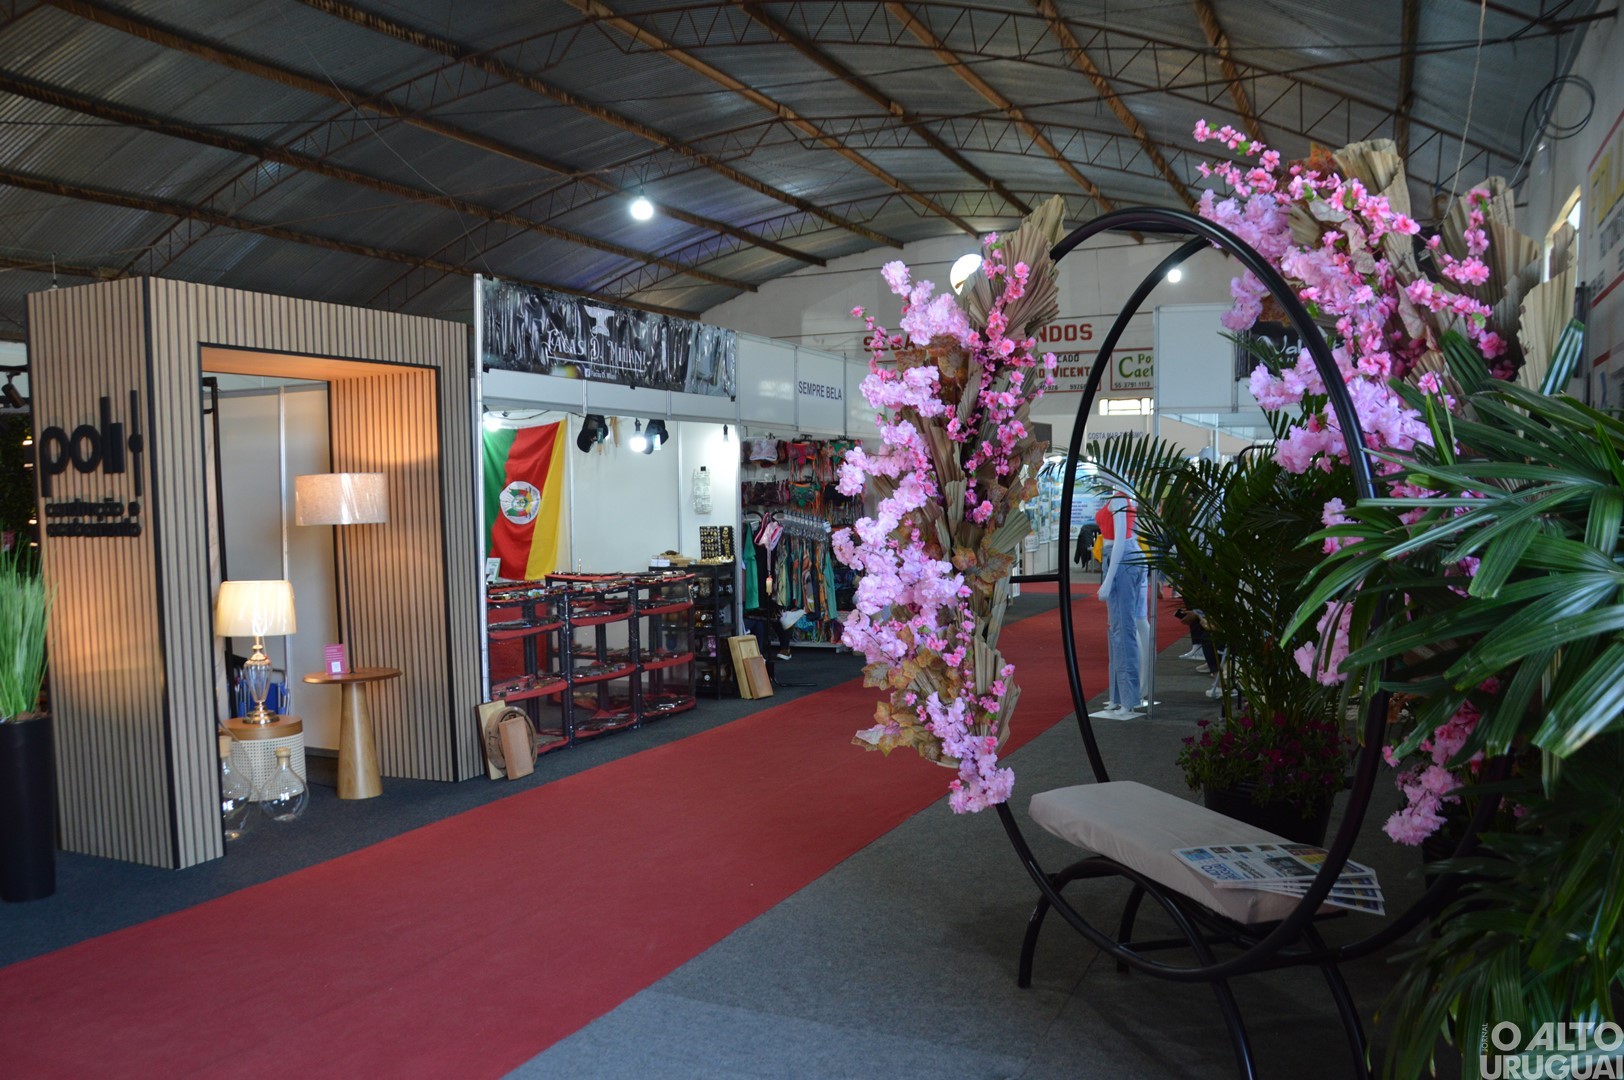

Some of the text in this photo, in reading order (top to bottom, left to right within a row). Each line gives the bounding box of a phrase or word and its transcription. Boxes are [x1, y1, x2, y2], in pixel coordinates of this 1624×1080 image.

[1036, 323, 1093, 343] NDOS
[1052, 365, 1090, 378] VICENT
[798, 381, 842, 400] SEMPRE BELA
[1088, 432, 1106, 440] COSTA
